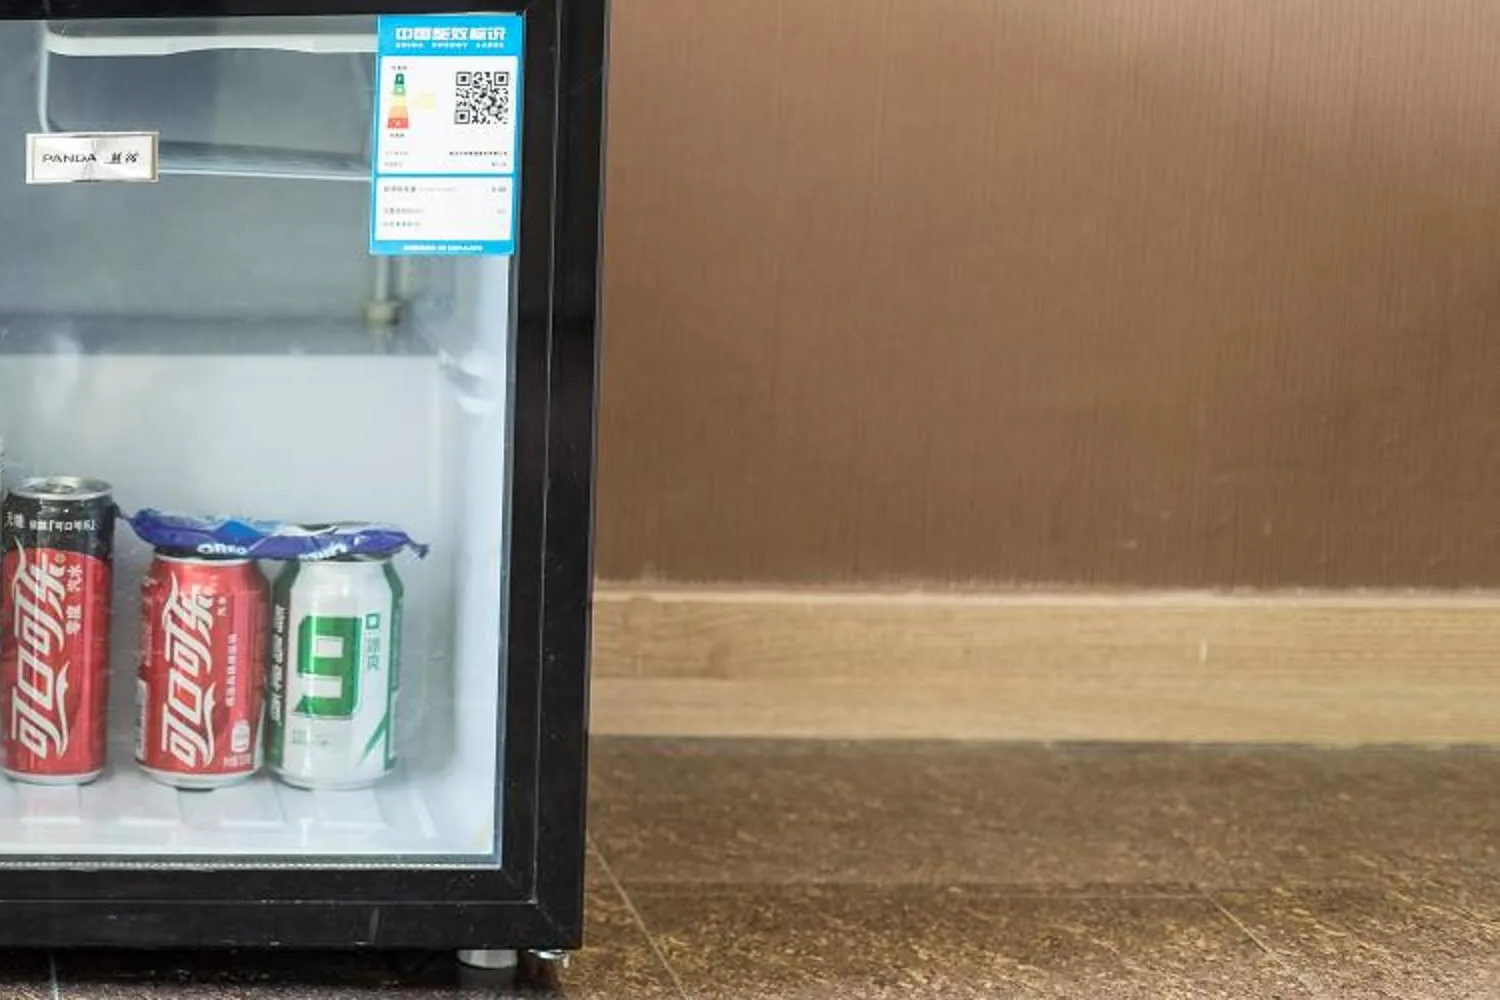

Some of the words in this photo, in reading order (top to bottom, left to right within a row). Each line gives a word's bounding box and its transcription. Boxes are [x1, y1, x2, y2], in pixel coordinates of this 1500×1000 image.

[42, 153, 97, 163] PANDA
[11, 536, 67, 761] 可口可乐
[161, 571, 215, 768] 可口可乐
